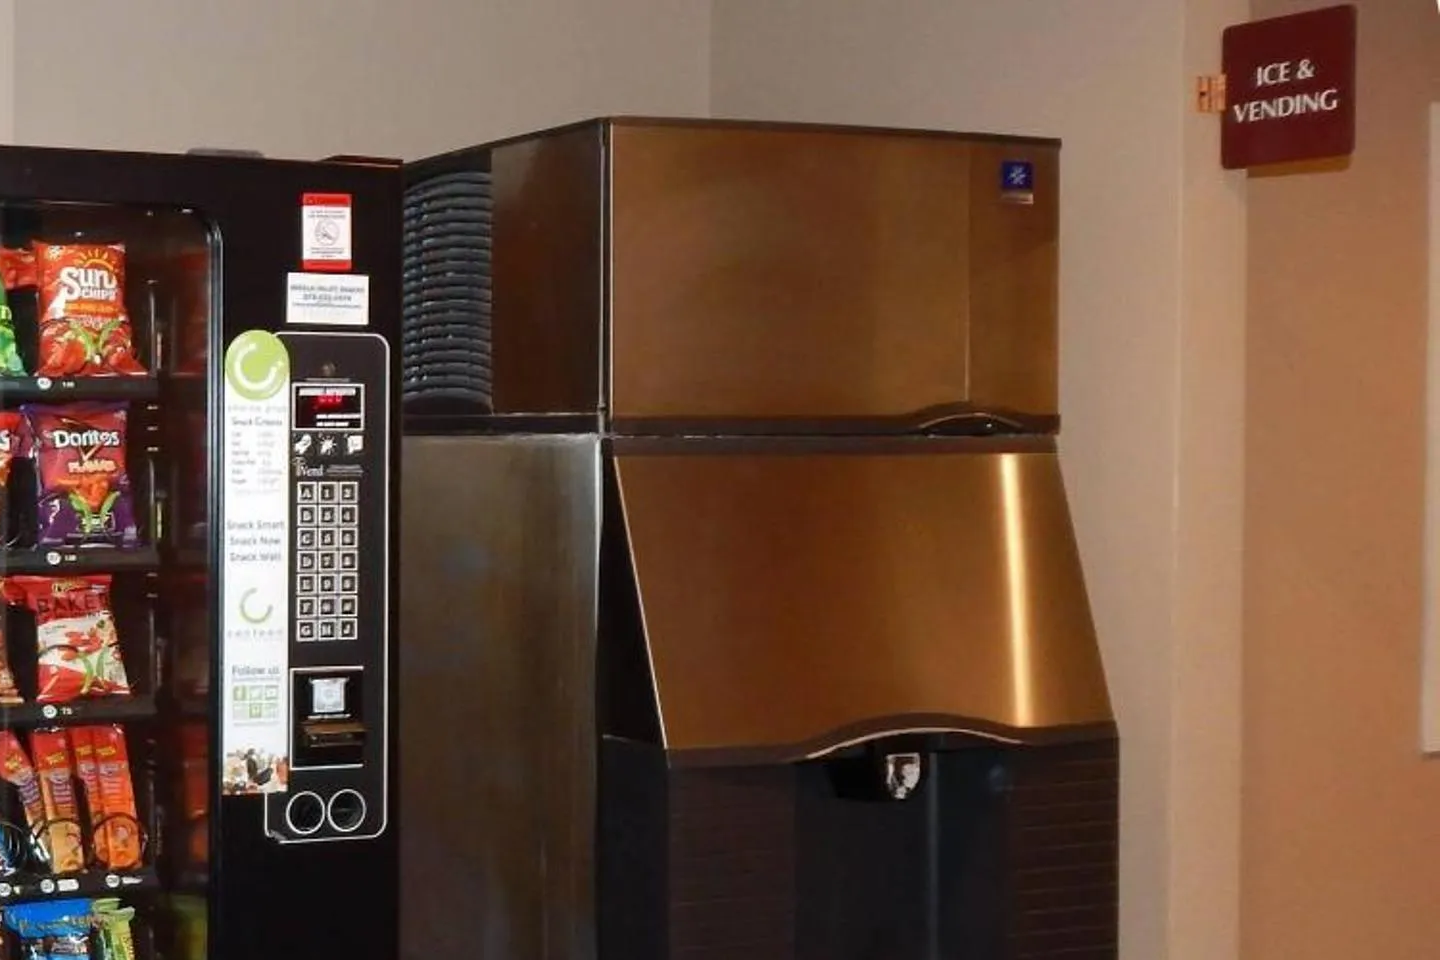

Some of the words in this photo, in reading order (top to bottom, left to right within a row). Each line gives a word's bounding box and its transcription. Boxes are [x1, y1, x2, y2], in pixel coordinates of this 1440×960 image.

[1256, 61, 1291, 87] ICE
[1297, 59, 1315, 80] &
[1232, 88, 1338, 123] VENDING
[60, 266, 117, 300] Sun
[53, 429, 120, 448] Doritos
